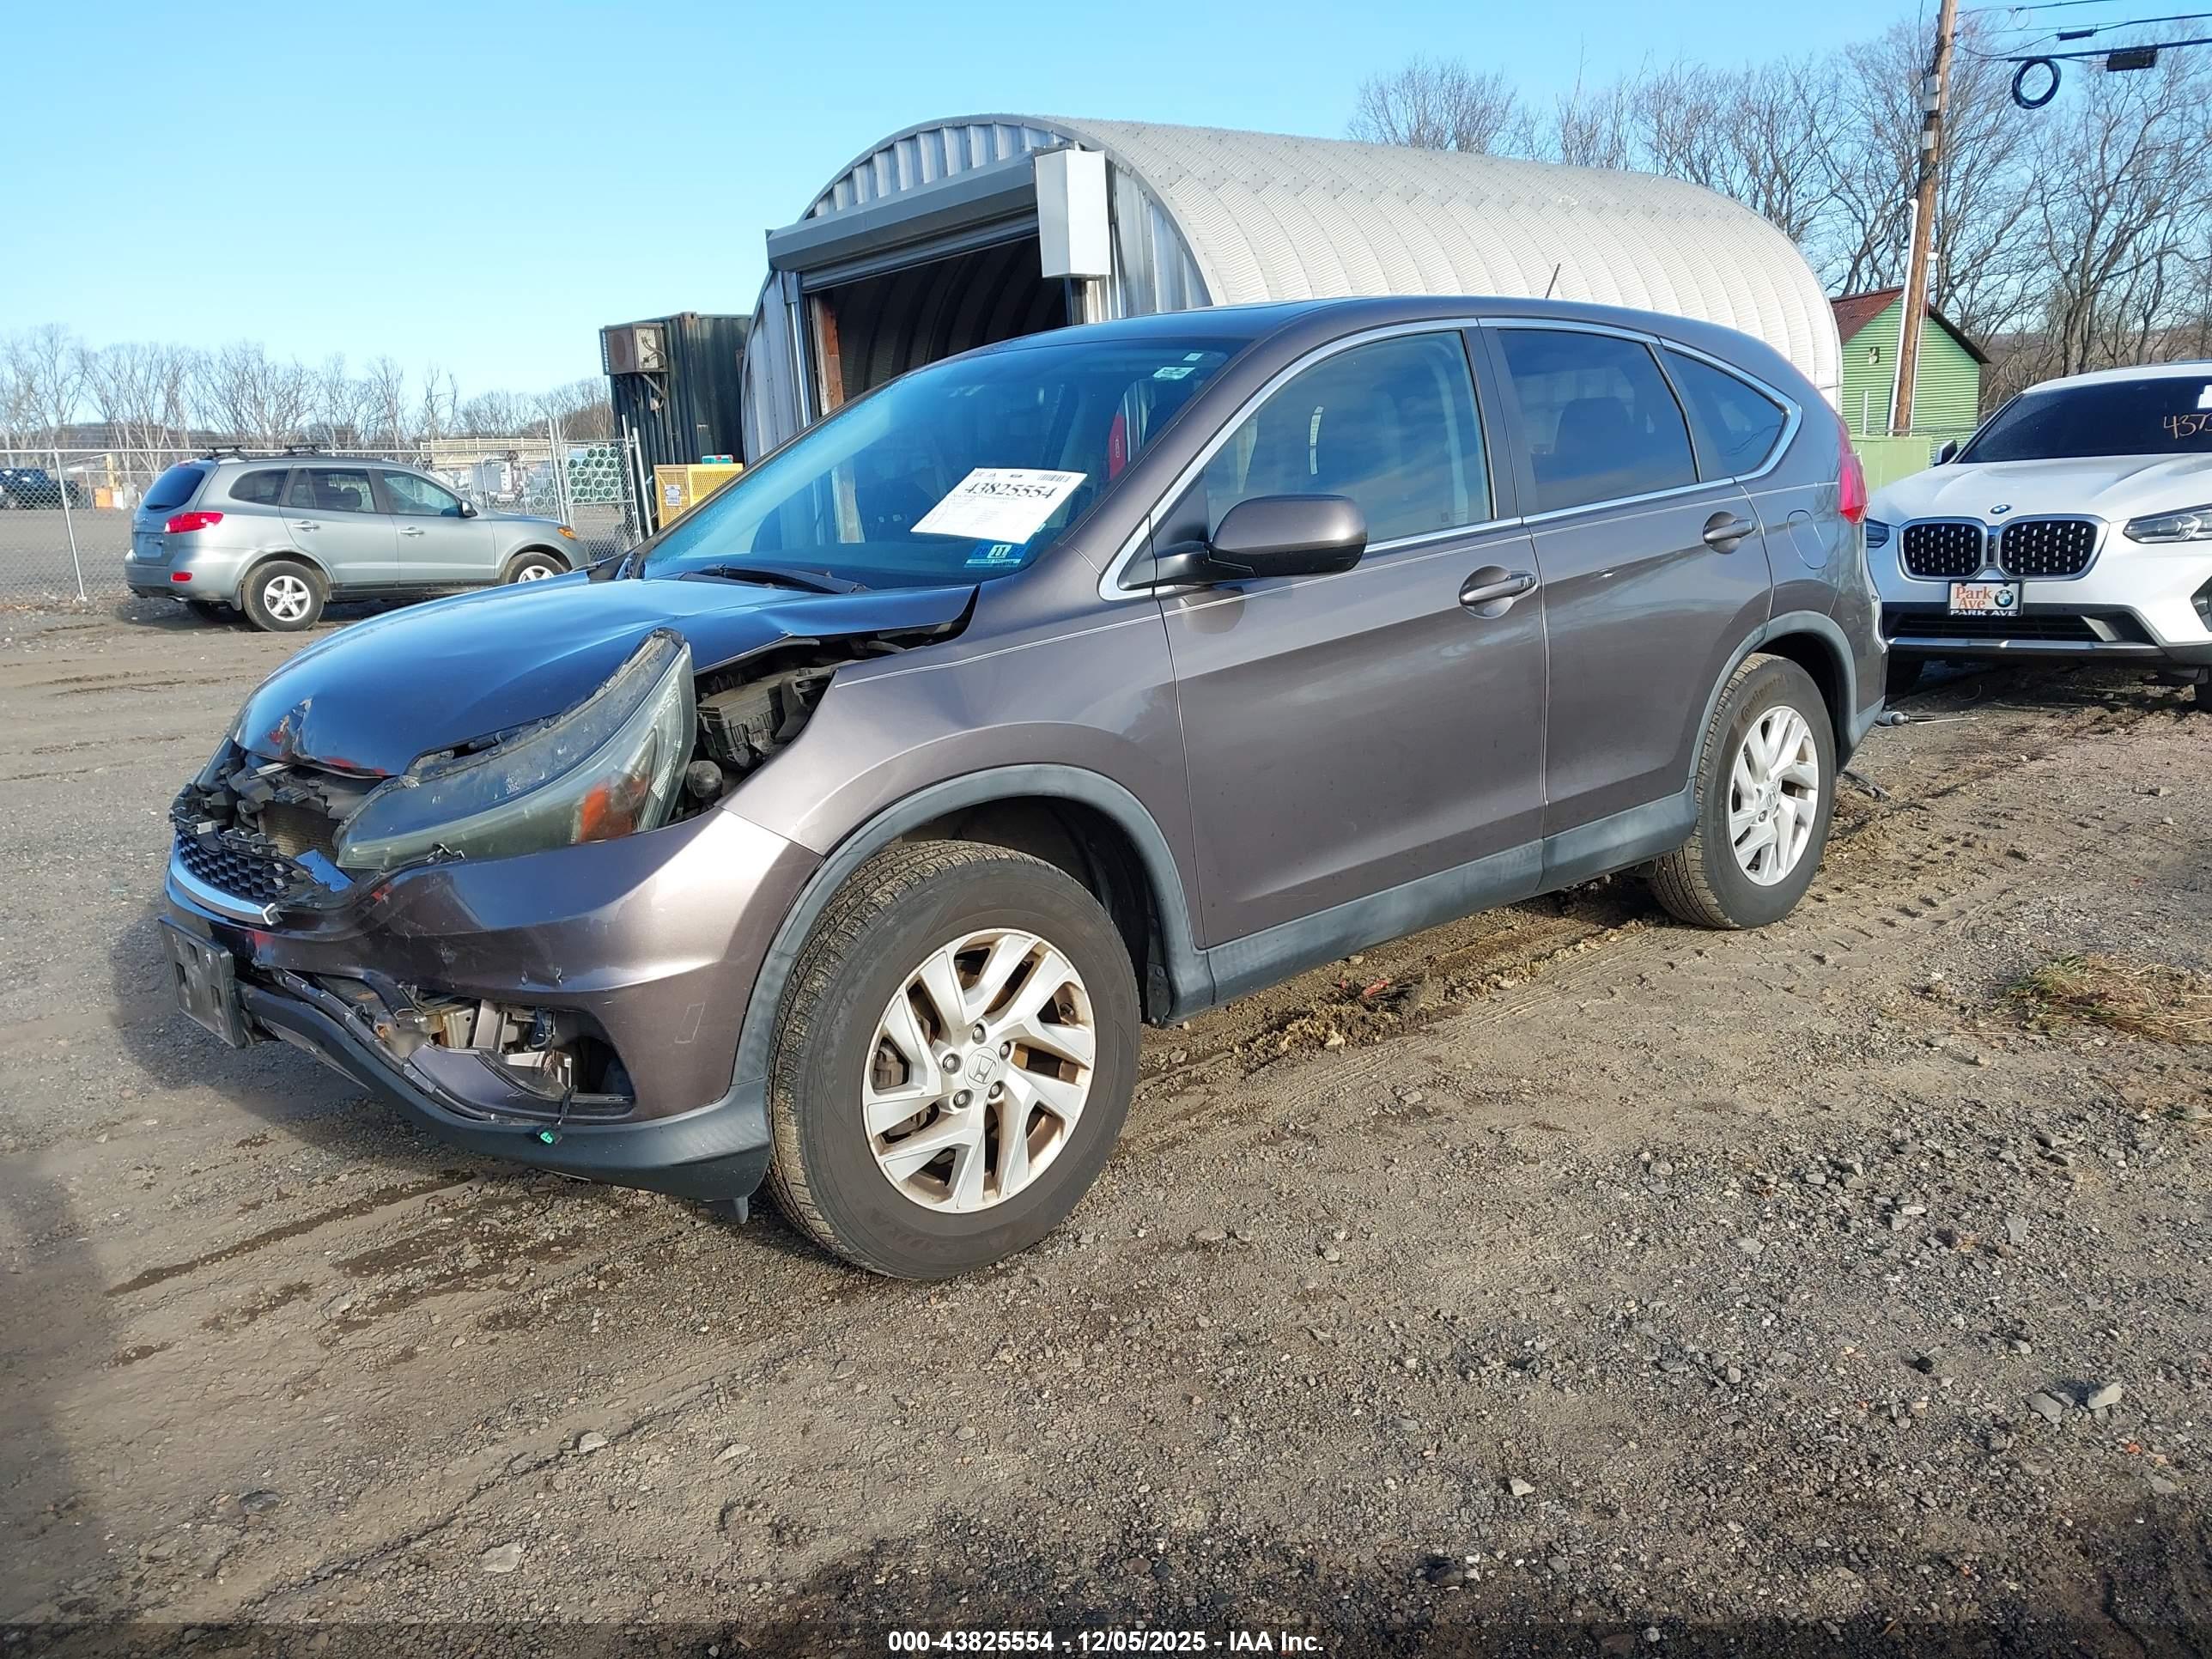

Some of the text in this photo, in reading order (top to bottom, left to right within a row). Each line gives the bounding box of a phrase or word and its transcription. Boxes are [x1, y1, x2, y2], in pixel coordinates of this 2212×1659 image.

[965, 482, 1058, 499] 43825554
[991, 546, 1006, 557] 11
[1955, 586, 1992, 599] Park
[1959, 598, 1985, 609] Ave
